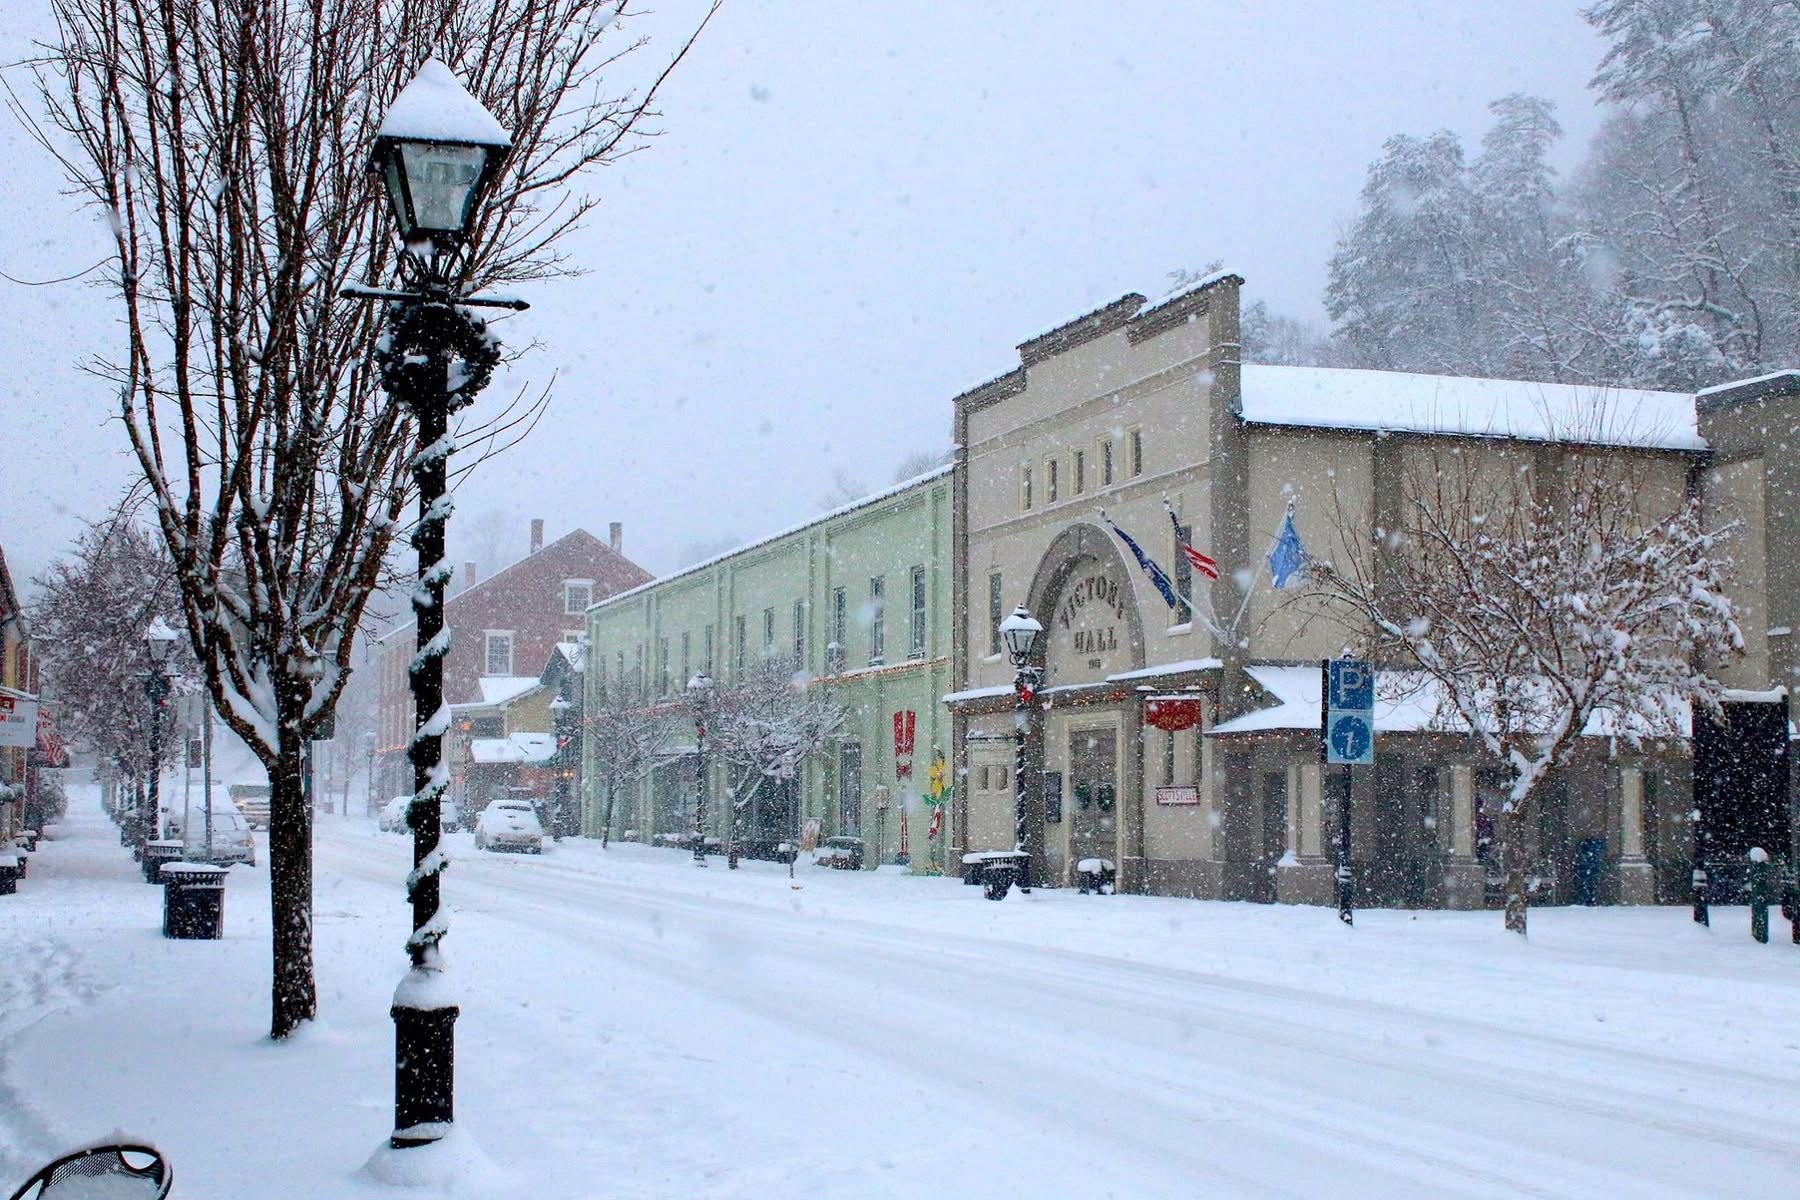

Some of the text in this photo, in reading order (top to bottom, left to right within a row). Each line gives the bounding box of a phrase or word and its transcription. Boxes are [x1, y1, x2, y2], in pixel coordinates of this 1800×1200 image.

[1059, 575, 1125, 630] VICTORY
[1074, 626, 1117, 655] HALL
[1340, 668, 1364, 703] P
